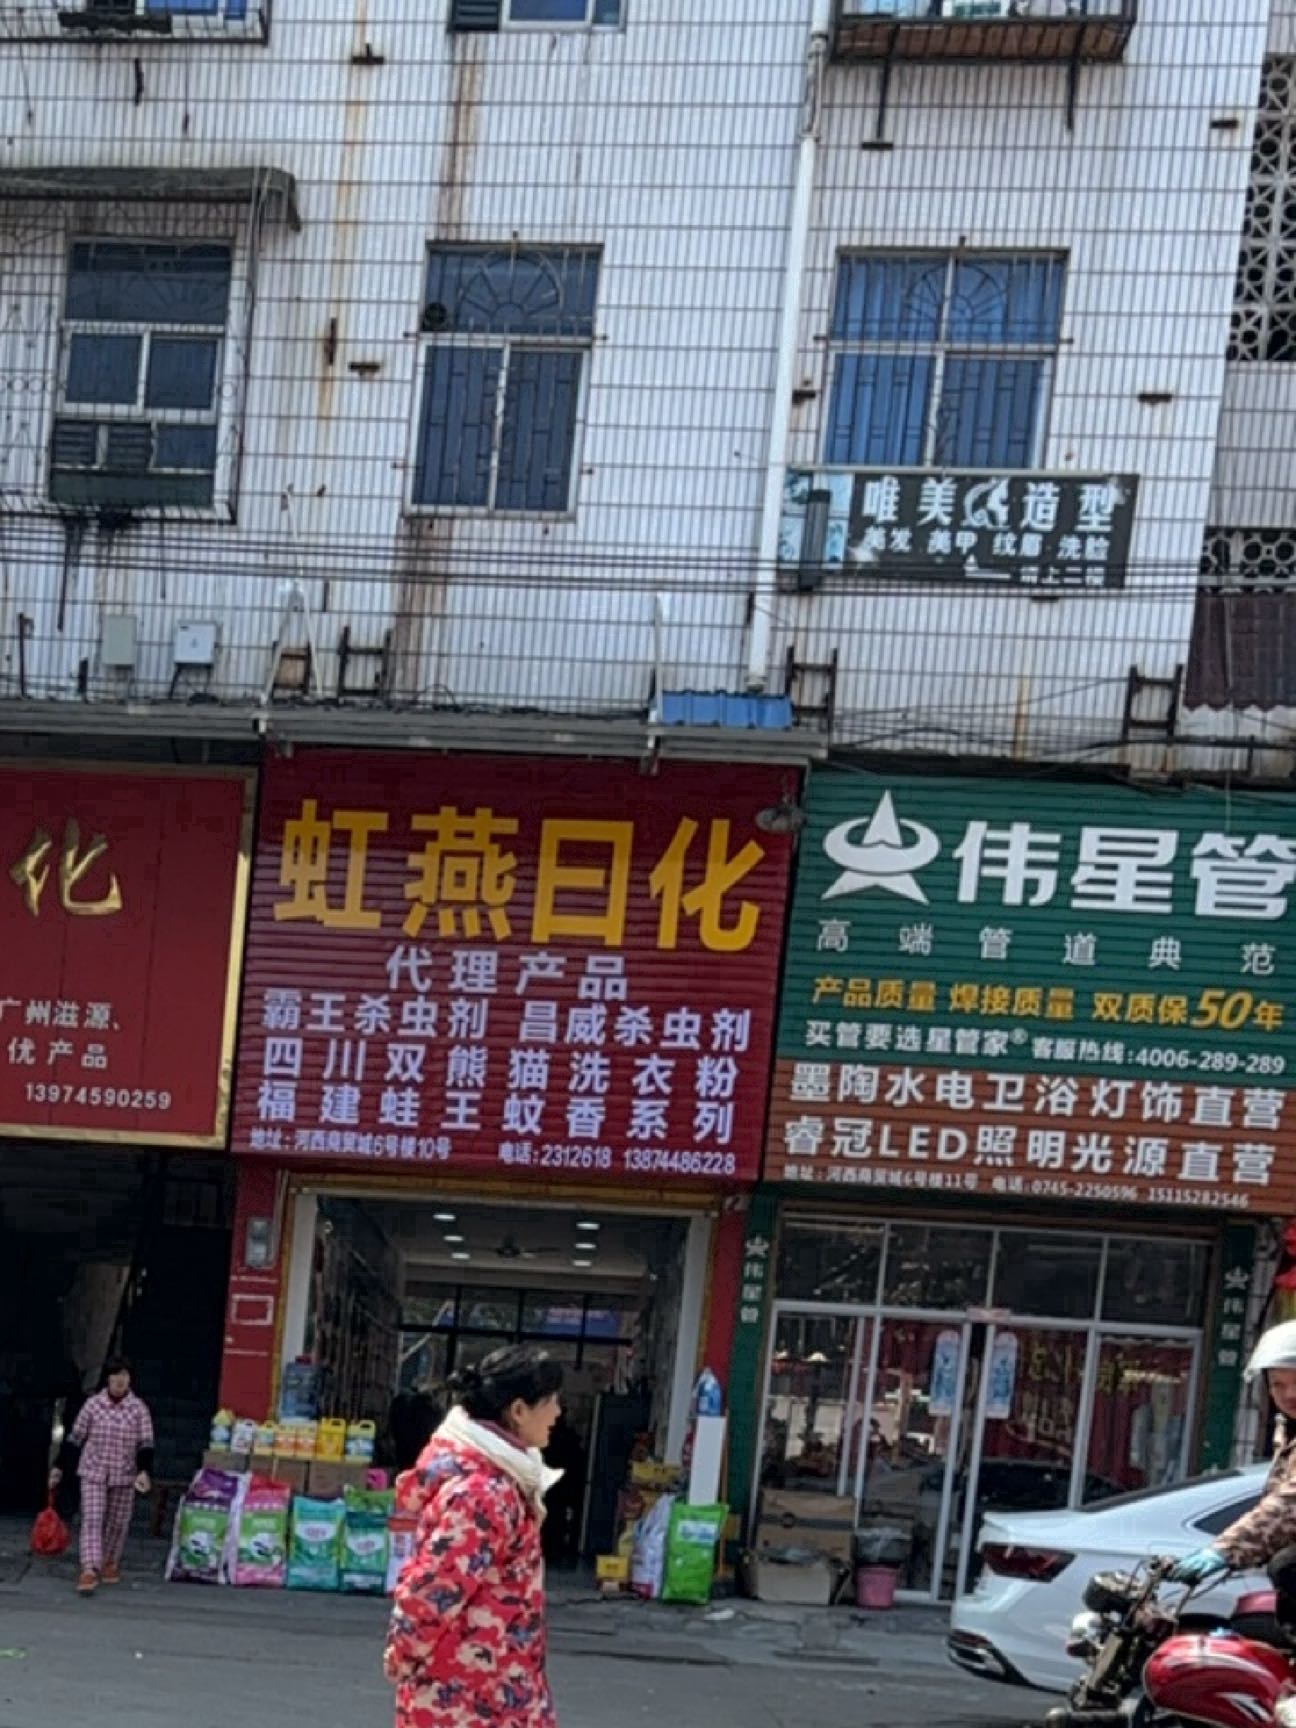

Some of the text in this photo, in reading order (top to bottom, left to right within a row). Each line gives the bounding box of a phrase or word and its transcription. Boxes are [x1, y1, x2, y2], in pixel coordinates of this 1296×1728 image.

[862, 475, 1113, 532] 唯美 造型
[274, 799, 766, 952] 虹燕日化
[952, 820, 1296, 921] 伟星管
[386, 945, 628, 1002] 代理产品
[816, 918, 1276, 977] 高端管道典范
[262, 989, 752, 1054] 霸王杀虫剂 昌威杀虫剂
[811, 976, 1284, 1032] 产品质量 焊接质量 双质保50年
[25, 1082, 173, 1110] 13974590259
[262, 1036, 739, 1099] 四川双熊猫洗衣粉
[789, 1062, 1286, 1131] 墨陶水电卫浴灯饰直营
[256, 1080, 735, 1146] 福建蛙王蚊香系列
[783, 1115, 1276, 1188] 睿冠LED照明光源直营
